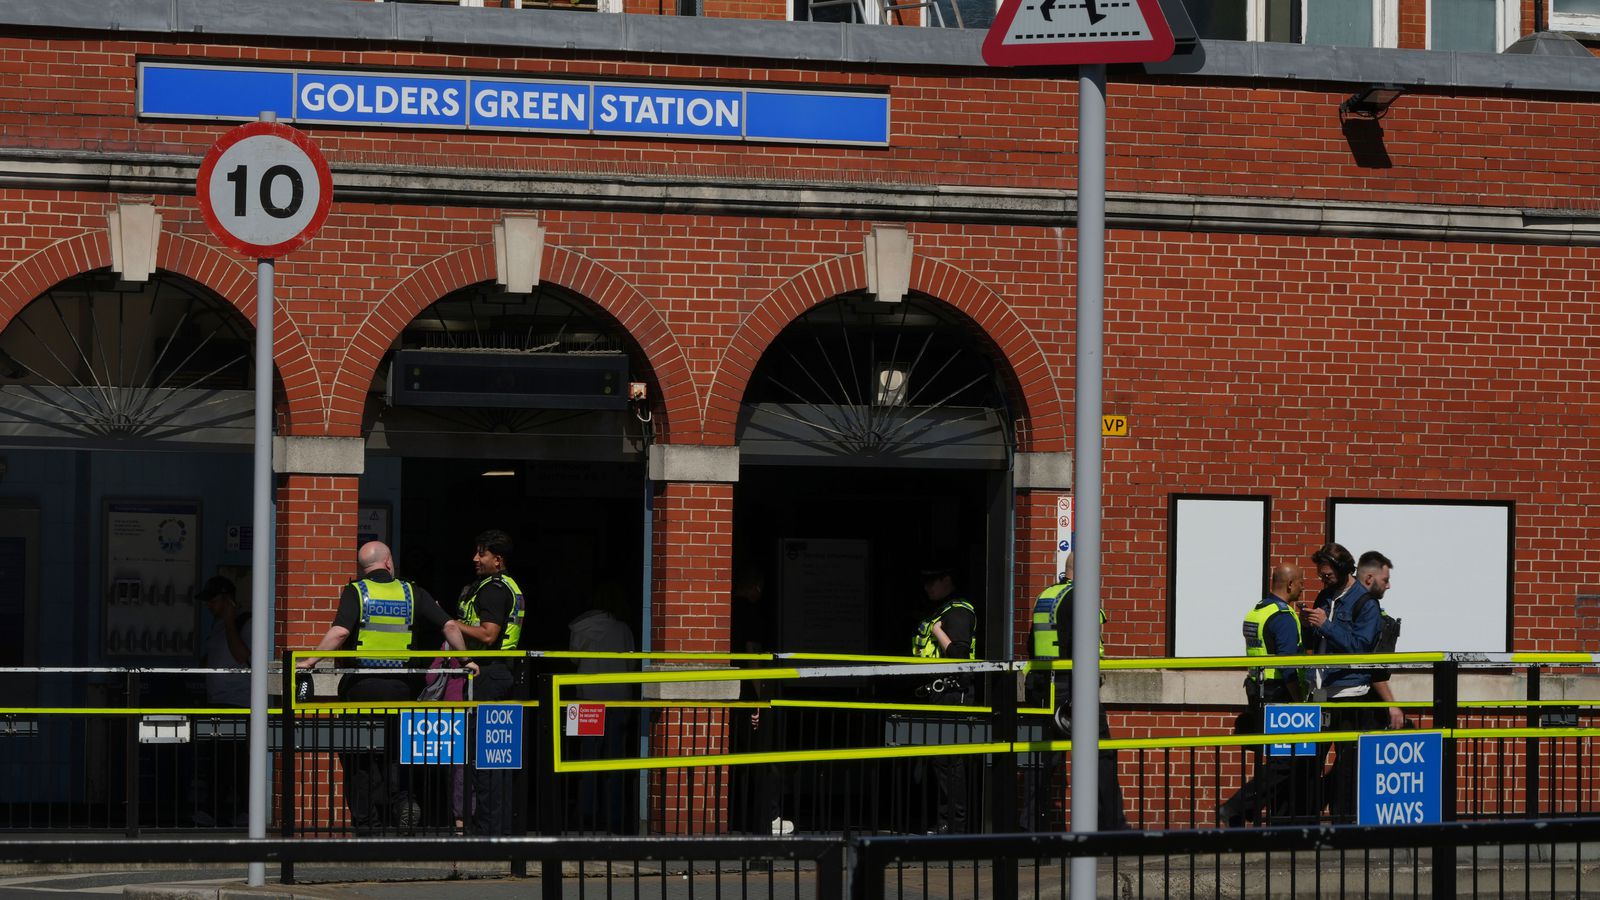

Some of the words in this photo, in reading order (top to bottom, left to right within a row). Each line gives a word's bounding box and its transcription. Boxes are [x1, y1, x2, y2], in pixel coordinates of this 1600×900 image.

[300, 82, 459, 118] GOLDERS
[474, 90, 585, 121] GREEN
[600, 93, 739, 128] STATION
[227, 164, 304, 219] 10
[1103, 418, 1124, 432] VP
[368, 605, 407, 616] POLICE
[485, 709, 514, 725] LOOK
[1270, 712, 1315, 729] LOOK
[407, 718, 462, 736] LOOK
[485, 729, 513, 744] BOTH
[412, 740, 456, 757] LEFT
[485, 748, 513, 764] WAYS
[1375, 741, 1425, 766] LOOK
[1376, 771, 1424, 795] BOTH
[1375, 801, 1424, 825] WAYS
